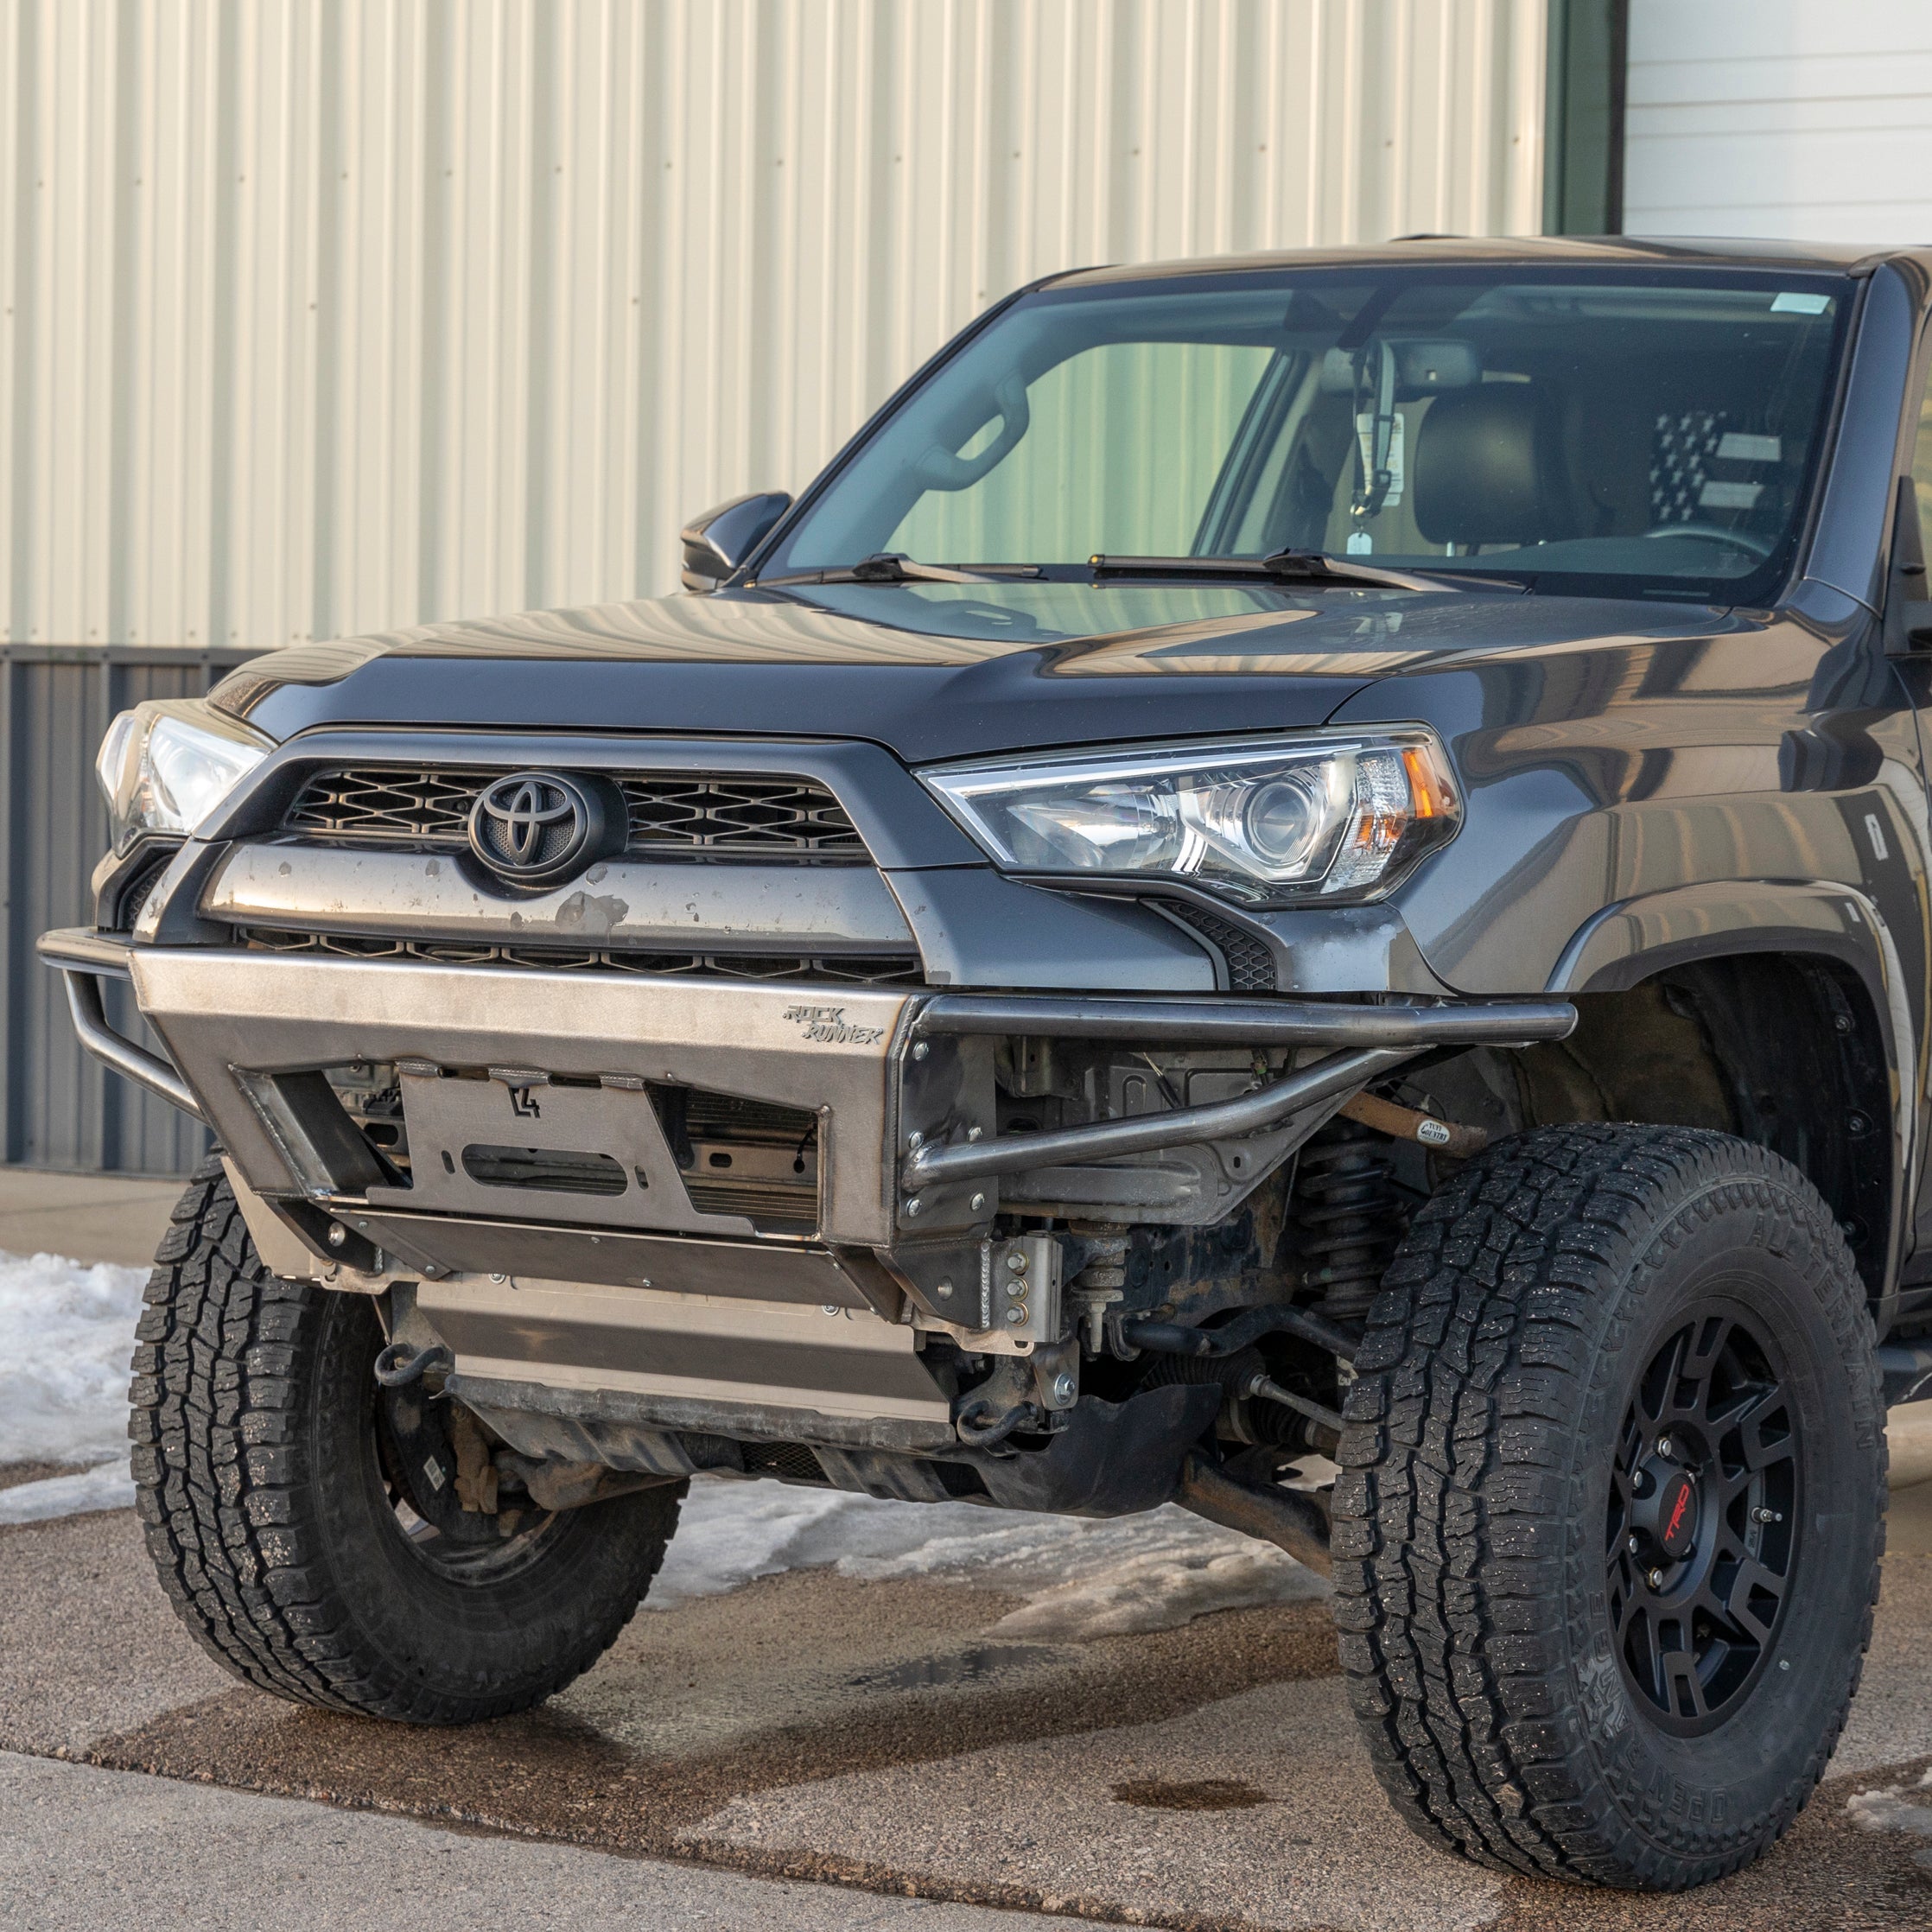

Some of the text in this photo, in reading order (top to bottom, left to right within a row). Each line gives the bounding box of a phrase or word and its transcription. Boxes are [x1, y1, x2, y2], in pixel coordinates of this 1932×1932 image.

[785, 1005, 845, 1025] ROCK
[804, 1023, 882, 1045] RUNNER
[1746, 1213, 1877, 1452] ALL TERRAIN
[1664, 1484, 1691, 1541] TRD
[1648, 1769, 1728, 1823] OPEN
